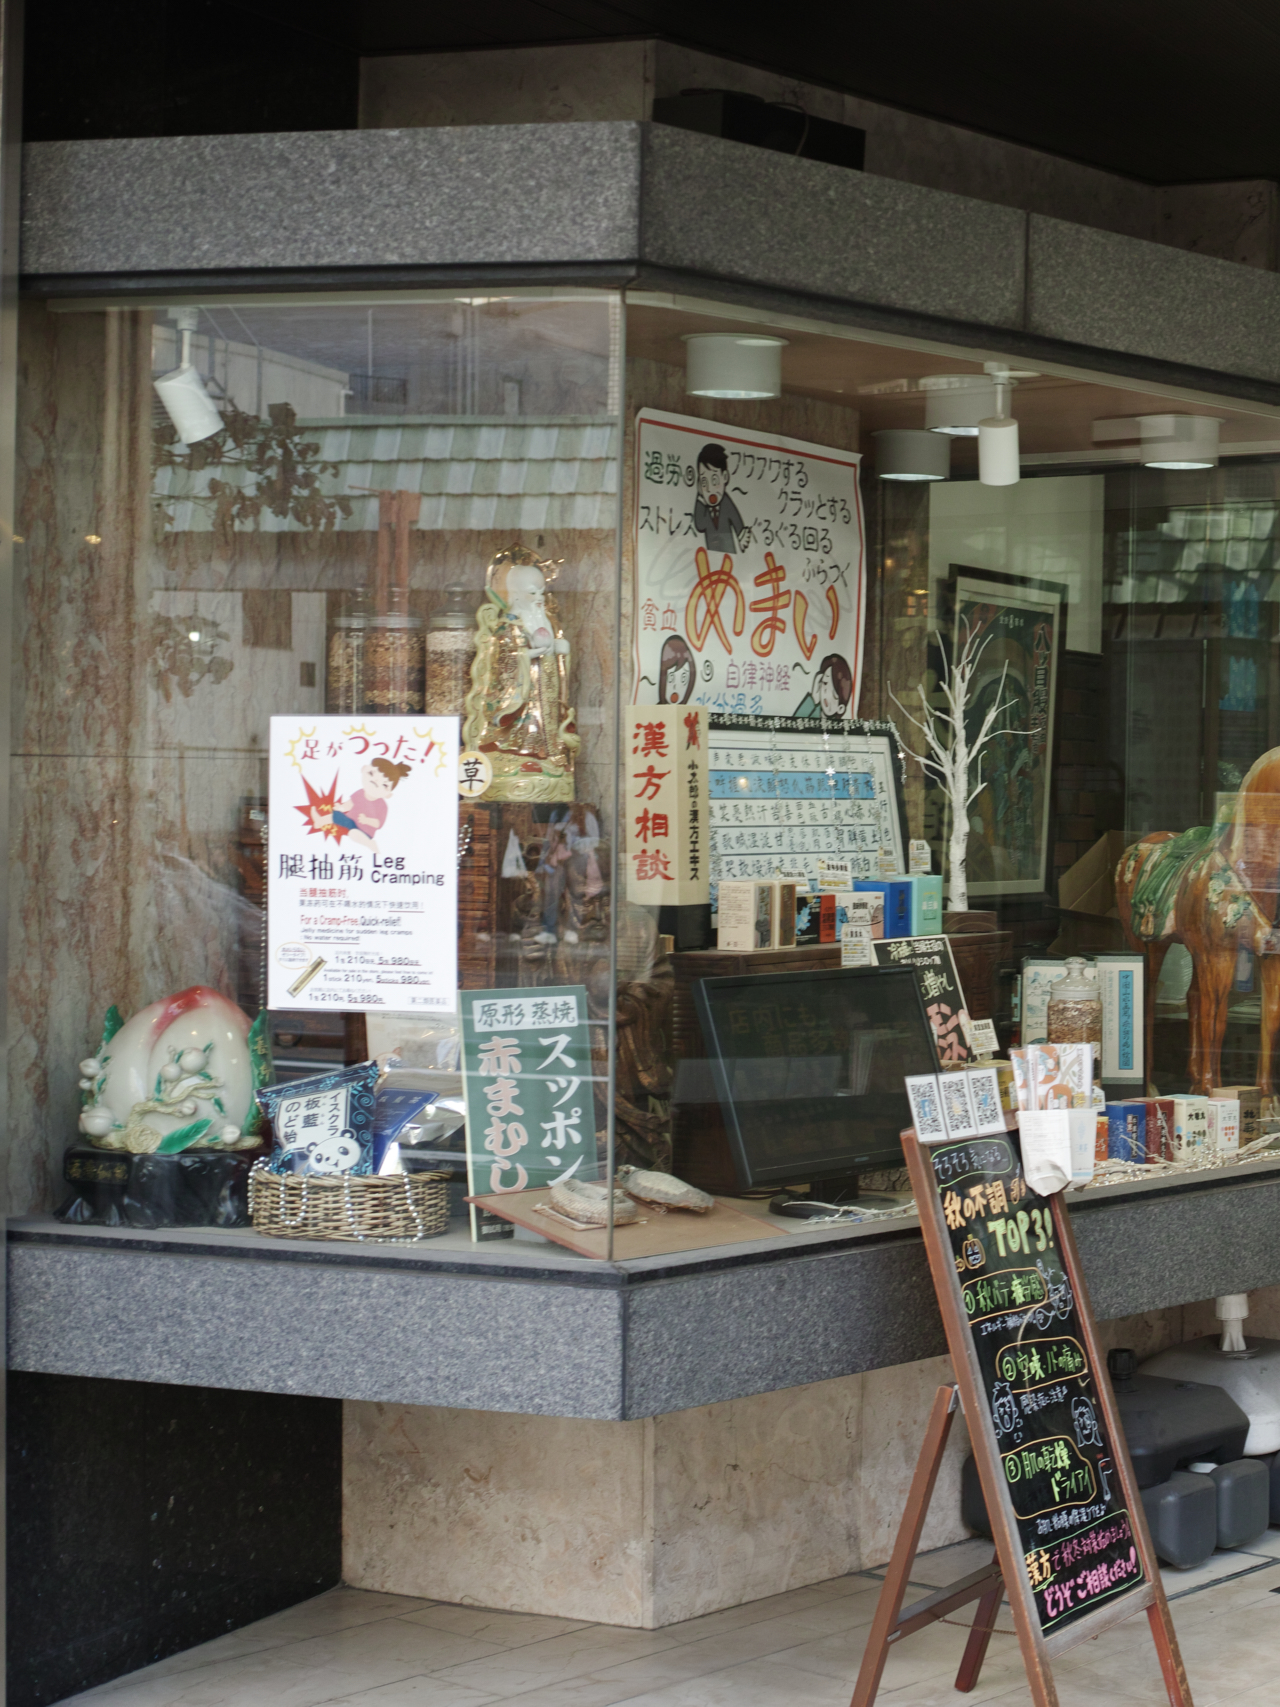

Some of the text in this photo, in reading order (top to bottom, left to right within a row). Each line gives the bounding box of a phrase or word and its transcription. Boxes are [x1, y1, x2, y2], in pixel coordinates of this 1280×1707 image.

[644, 450, 682, 487] 過労
[729, 451, 808, 488] フワフワする
[639, 505, 697, 538] ストレス
[778, 487, 850, 524] クラッとする
[802, 558, 850, 587] ふらつく
[640, 598, 677, 632] 貧血
[685, 546, 839, 661] めまい
[726, 660, 791, 692] 自律神経
[301, 735, 436, 764] 足がつった!
[459, 758, 485, 791] 草
[632, 721, 675, 881] 漢方相談
[686, 759, 700, 881] 小太郎の漢方エキス
[278, 853, 364, 881] 腿抽筋
[371, 870, 445, 886] Cramping
[373, 853, 406, 870] Leg
[478, 1001, 576, 1027] 原形 蒸焼
[284, 1101, 302, 1144] のど飴
[327, 1091, 342, 1136] イスクラ
[477, 1036, 529, 1194] 赤まむし
[943, 1180, 1009, 1230] 秋の不調
[1051, 1466, 1092, 1502] ドライアイ
